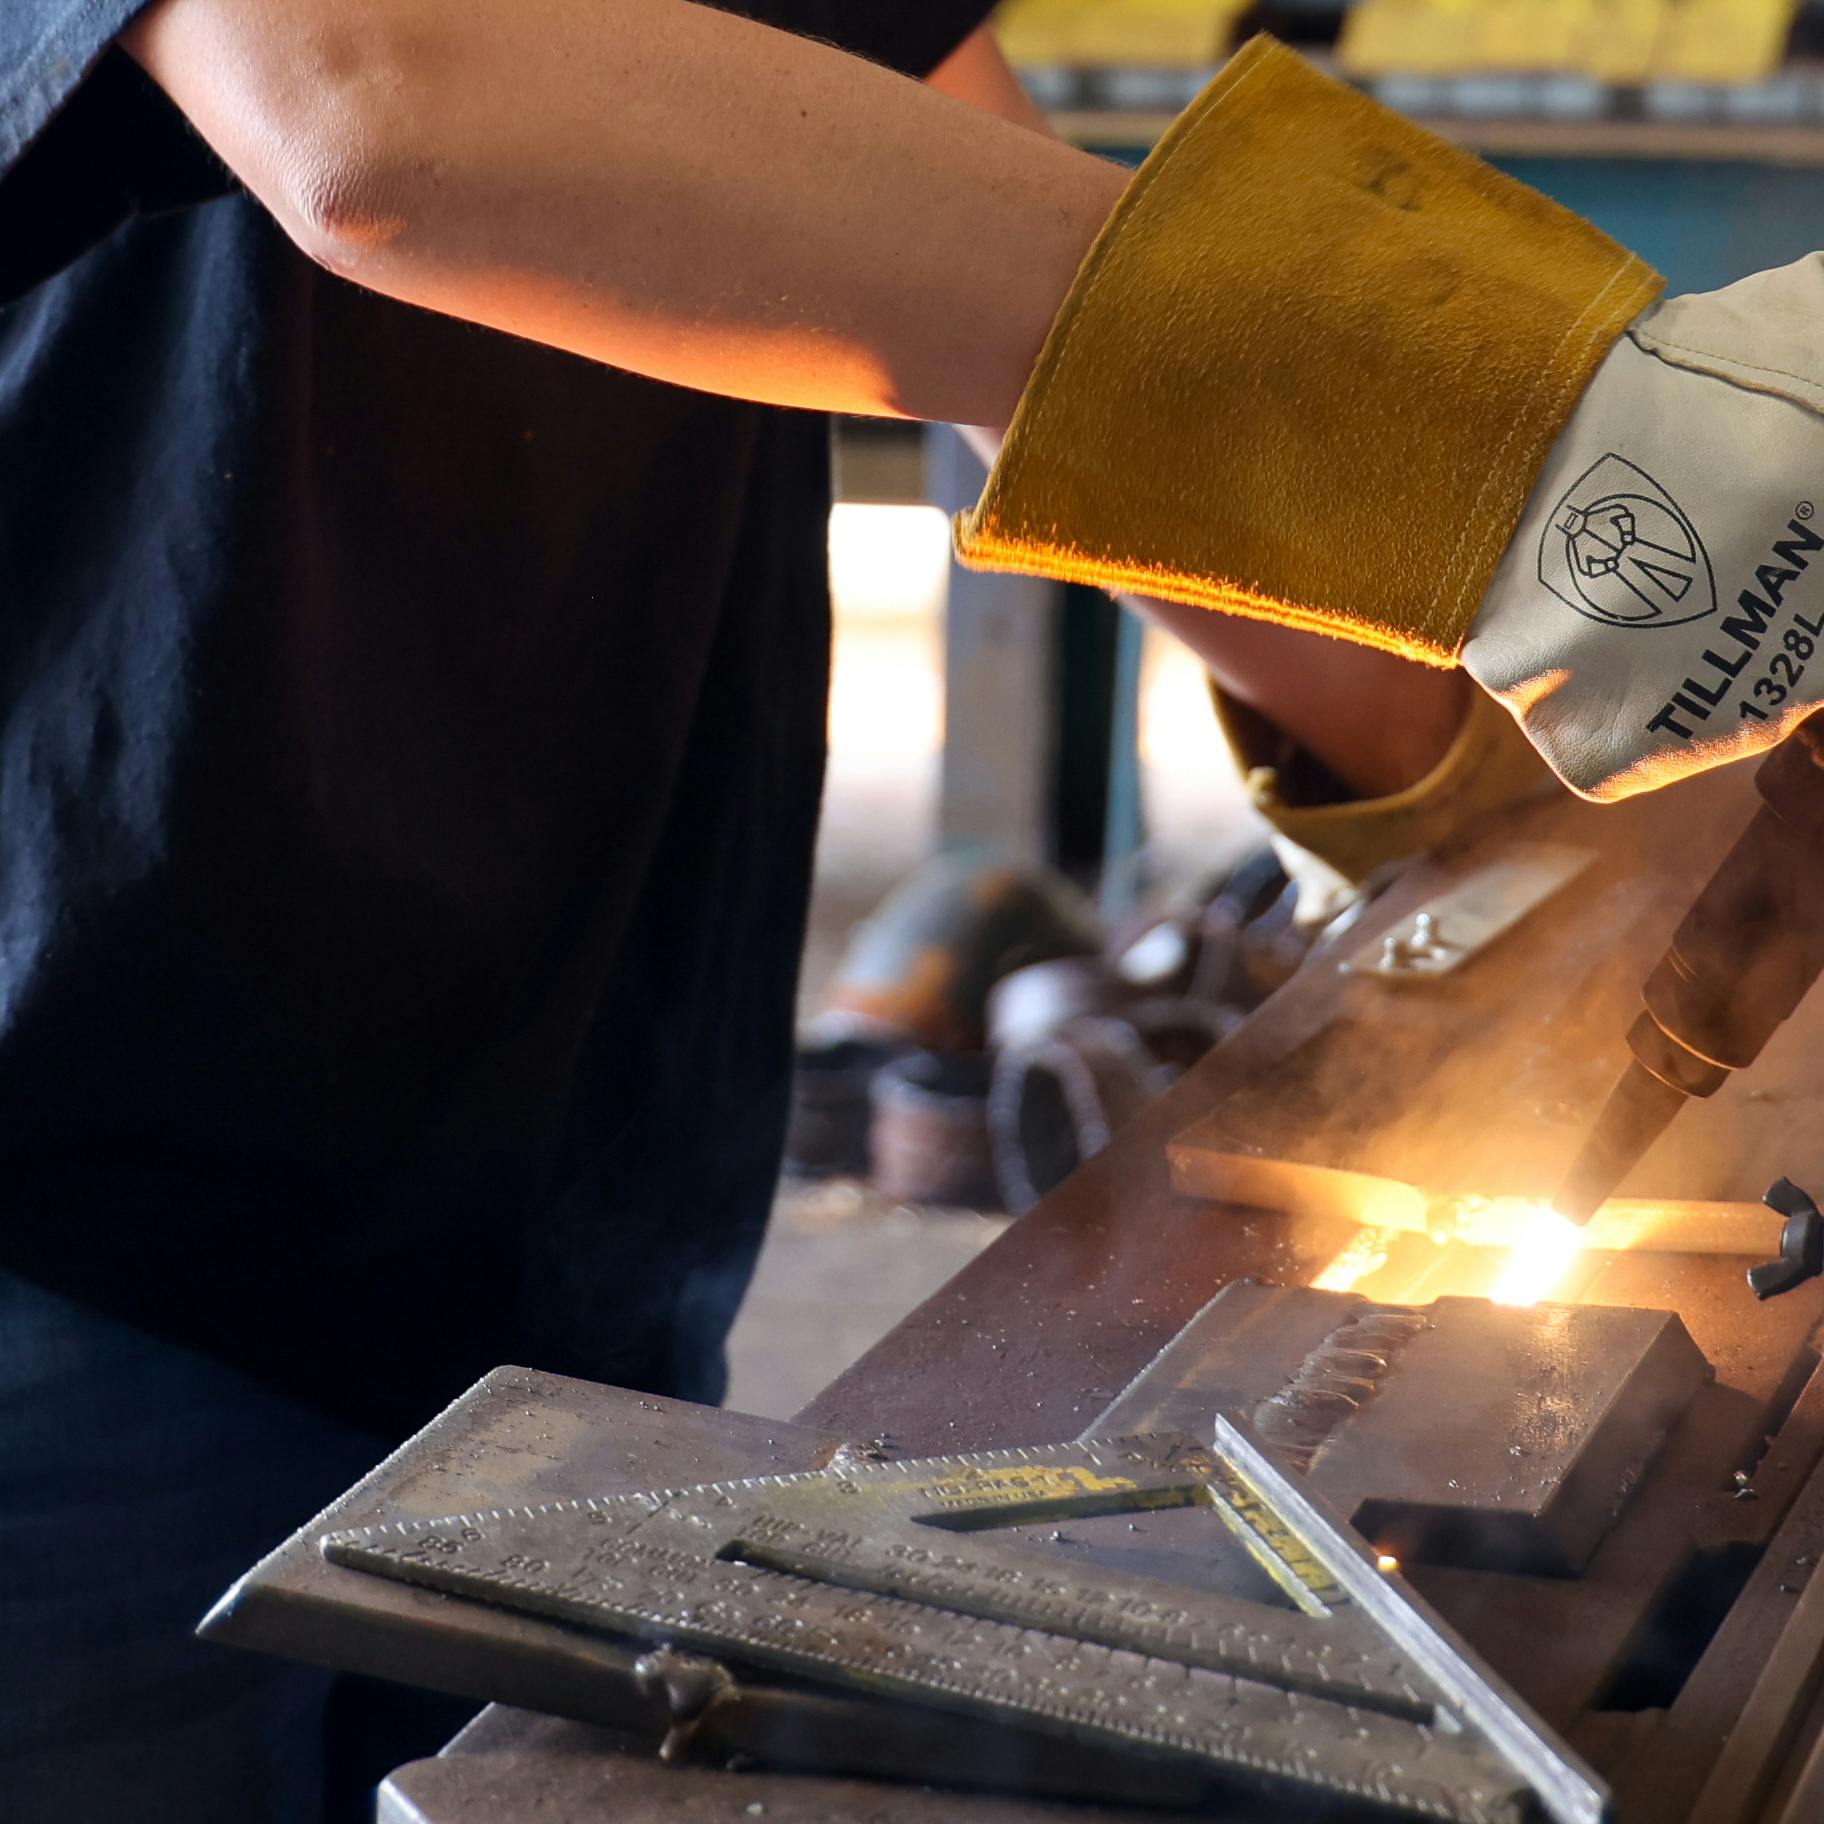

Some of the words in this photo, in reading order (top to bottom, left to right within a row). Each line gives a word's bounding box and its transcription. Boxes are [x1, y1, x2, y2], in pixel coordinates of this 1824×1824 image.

[417, 1535, 465, 1554] 85
[460, 1527, 482, 1543] 6
[499, 1553, 551, 1574] 80
